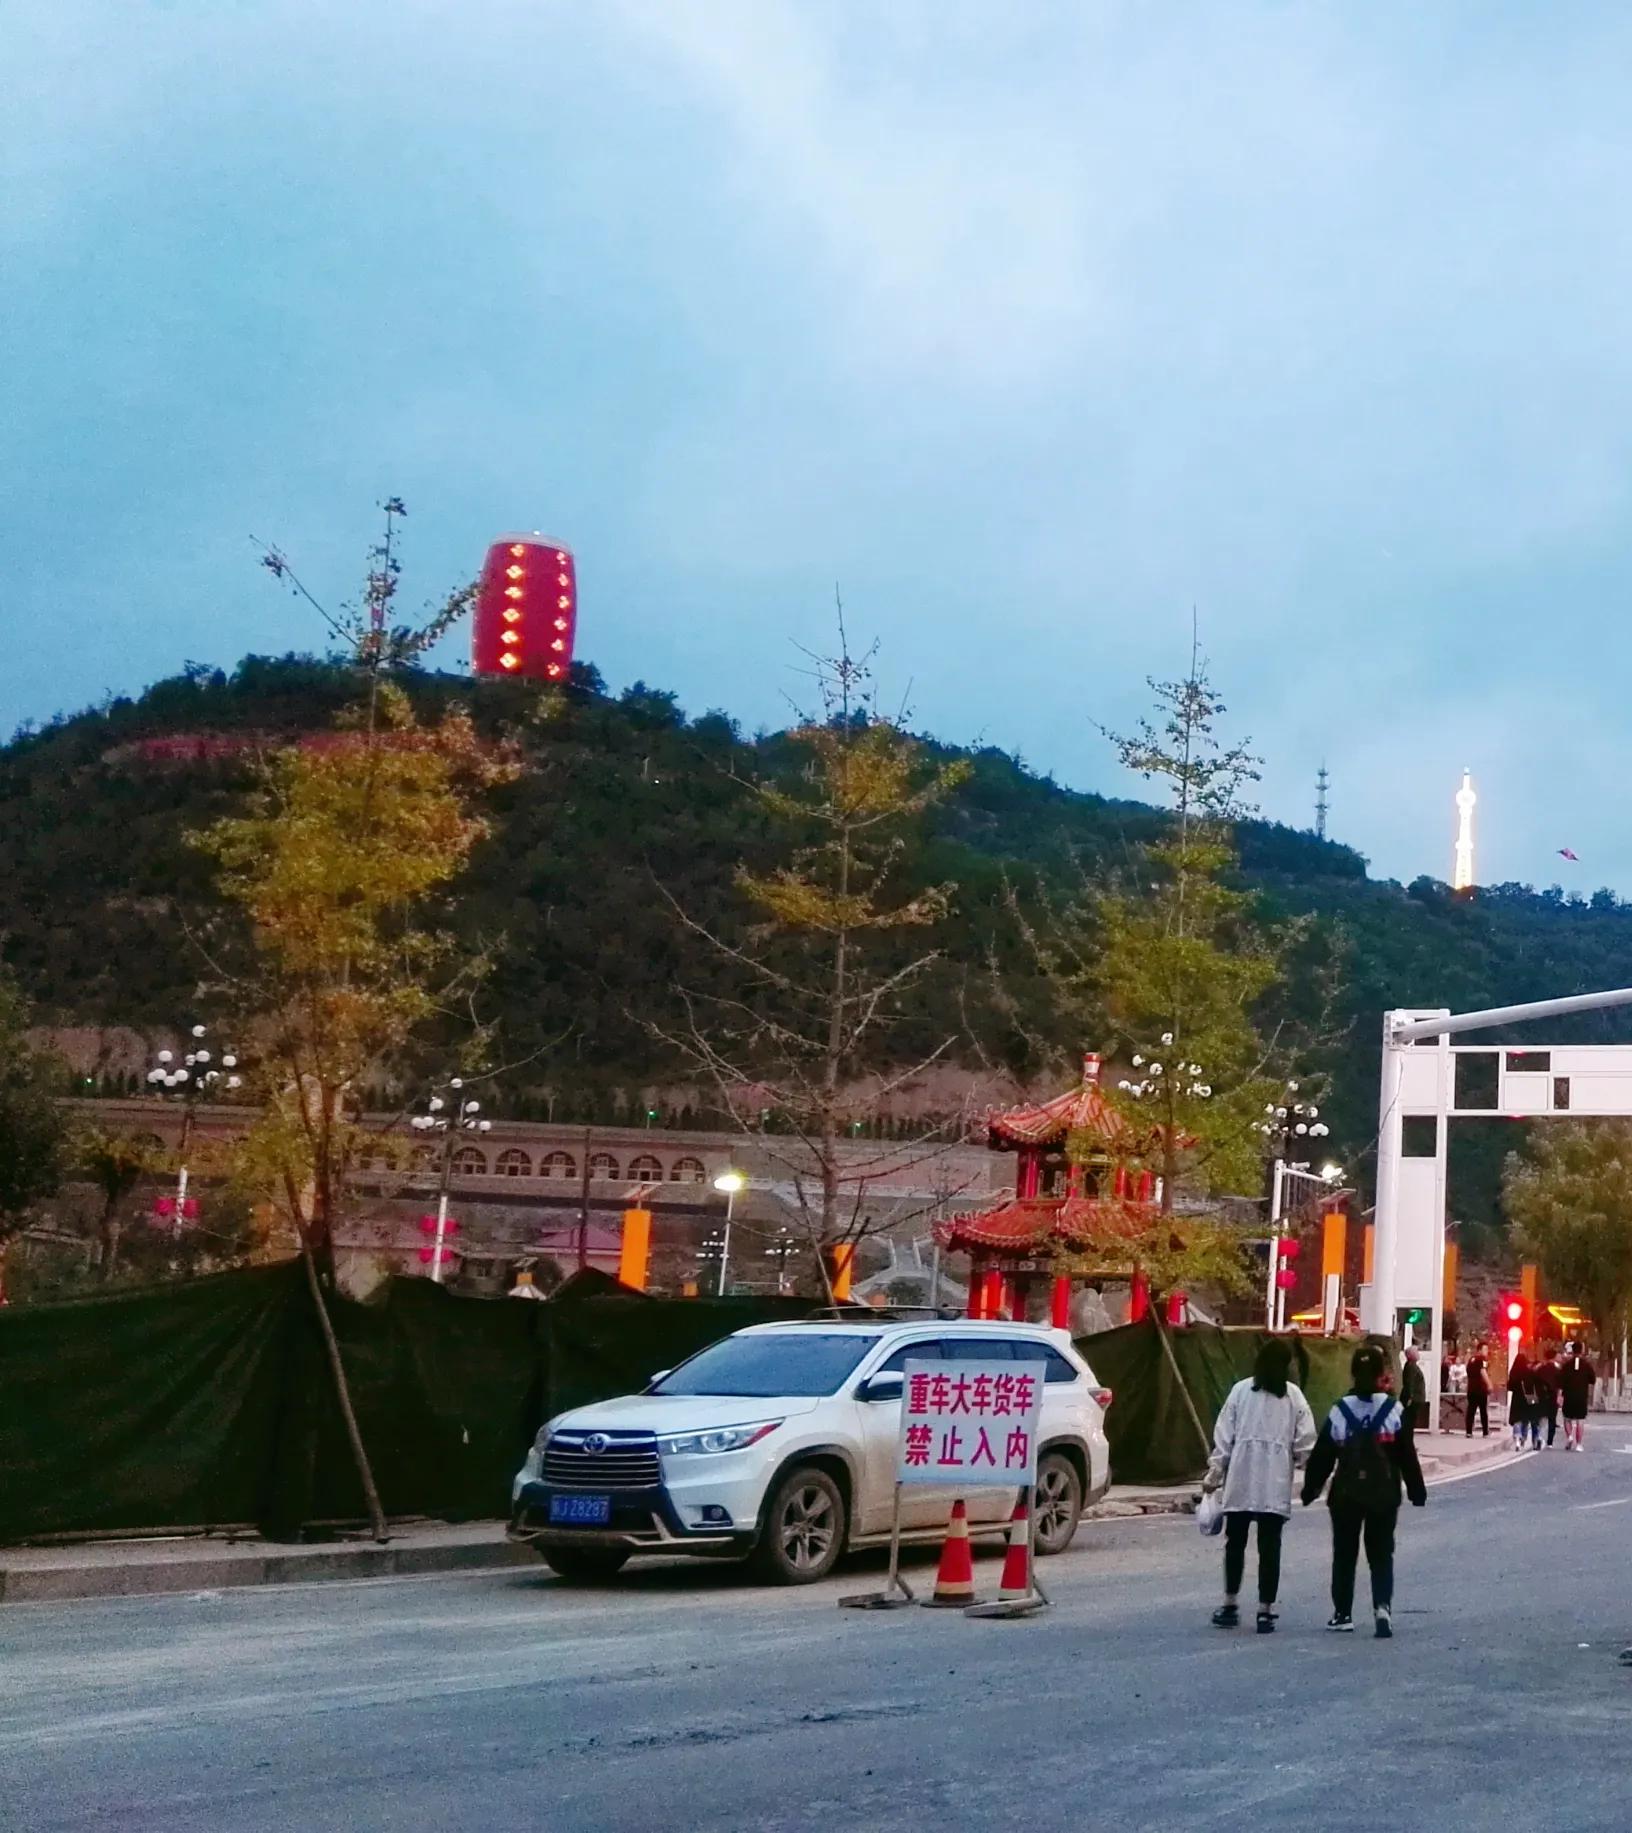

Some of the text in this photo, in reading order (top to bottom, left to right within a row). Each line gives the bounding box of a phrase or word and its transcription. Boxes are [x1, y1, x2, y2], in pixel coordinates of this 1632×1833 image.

[908, 1372, 1036, 1417] 重车大车货车
[904, 1423, 1029, 1470] 禁止入内
